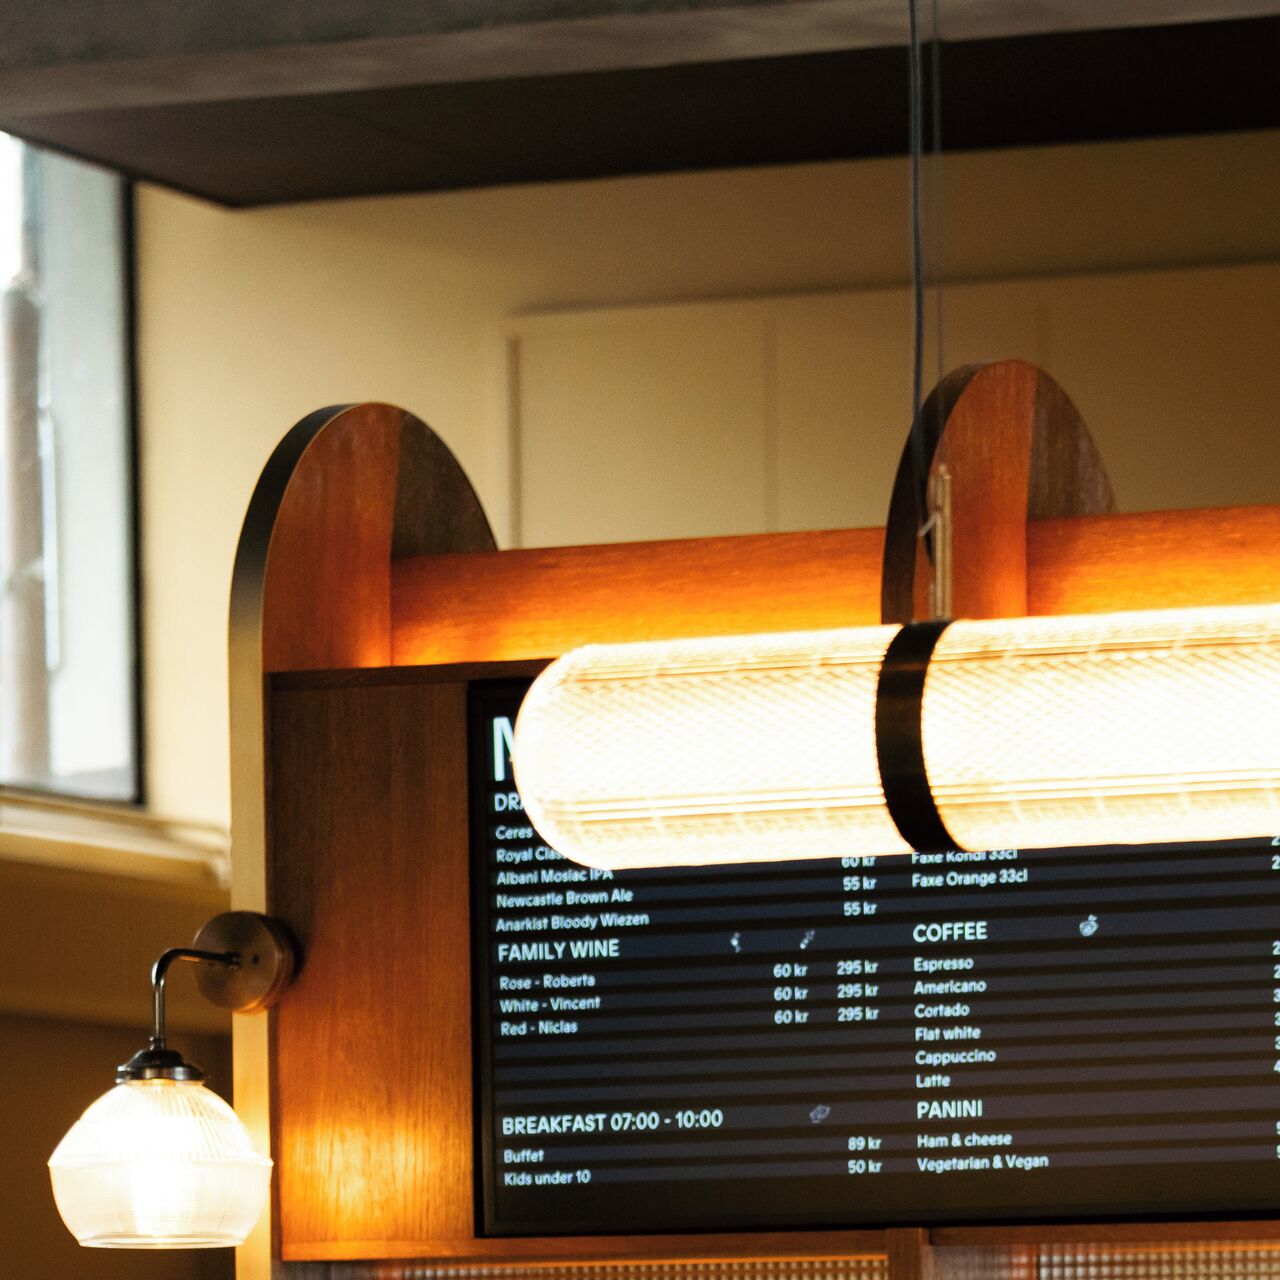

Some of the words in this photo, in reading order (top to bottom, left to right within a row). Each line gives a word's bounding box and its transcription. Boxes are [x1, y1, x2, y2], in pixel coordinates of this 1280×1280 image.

[495, 826, 533, 840] Ceres
[496, 848, 533, 864] Royal
[841, 856, 860, 868] 60
[862, 856, 876, 867] kr
[912, 852, 944, 864] Faxe
[497, 870, 538, 885] Albani
[590, 870, 614, 881] IPA
[843, 877, 860, 891] 55
[862, 876, 877, 890] kr
[912, 873, 944, 888] Faxe
[946, 871, 997, 887] Orange
[999, 868, 1028, 883] 33cl
[497, 893, 563, 908] Newcastle
[566, 891, 608, 904] Brown
[611, 888, 633, 902] Ale
[844, 902, 861, 916] 55
[863, 901, 877, 915] kr
[496, 916, 548, 932] Anarkist
[551, 915, 598, 930] Bloody
[912, 921, 988, 942] COFFEE
[498, 942, 566, 962] FAMILY
[570, 939, 620, 958] WINE
[773, 963, 791, 978] 60
[794, 963, 808, 977] kr
[837, 960, 862, 975] 295
[864, 960, 879, 973] kr
[913, 957, 974, 973] Espresso
[500, 976, 532, 990] Rose
[543, 974, 596, 988] Roberta
[913, 980, 987, 995] Americano
[774, 986, 792, 1001] 60
[794, 986, 808, 1000] kr
[837, 983, 862, 998] 295
[865, 983, 879, 997] kr
[500, 998, 539, 1013] White
[550, 996, 601, 1011] Vincent
[914, 1002, 970, 1018] Cortado
[774, 1010, 792, 1024] 60
[795, 1010, 809, 1023] kr
[838, 1007, 863, 1022] 295
[865, 1007, 880, 1020] kr
[501, 1021, 527, 1036] Red
[538, 1020, 578, 1034] Niclas
[915, 1027, 940, 1041] Flat
[943, 1026, 981, 1040] white
[915, 1049, 997, 1066] Cappuccino
[916, 1074, 951, 1088] Latte
[917, 1100, 983, 1119] PANINI
[502, 1114, 607, 1135] BREAKFAST
[610, 1112, 660, 1131] 07:00
[675, 1109, 723, 1129] 10:00
[848, 1137, 865, 1151] 89
[867, 1136, 882, 1150] kr
[917, 1134, 948, 1148] Ham
[951, 1133, 961, 1147] &
[964, 1132, 1012, 1146] cheese
[503, 1148, 544, 1164] Buffet
[917, 1157, 990, 1174] Vegetarian
[992, 1154, 1002, 1169] &
[1006, 1154, 1049, 1170] Vegan
[848, 1160, 865, 1174] 50
[868, 1159, 882, 1173] kr
[504, 1172, 532, 1186] Kids
[535, 1170, 573, 1185] under
[575, 1169, 591, 1184] 10
